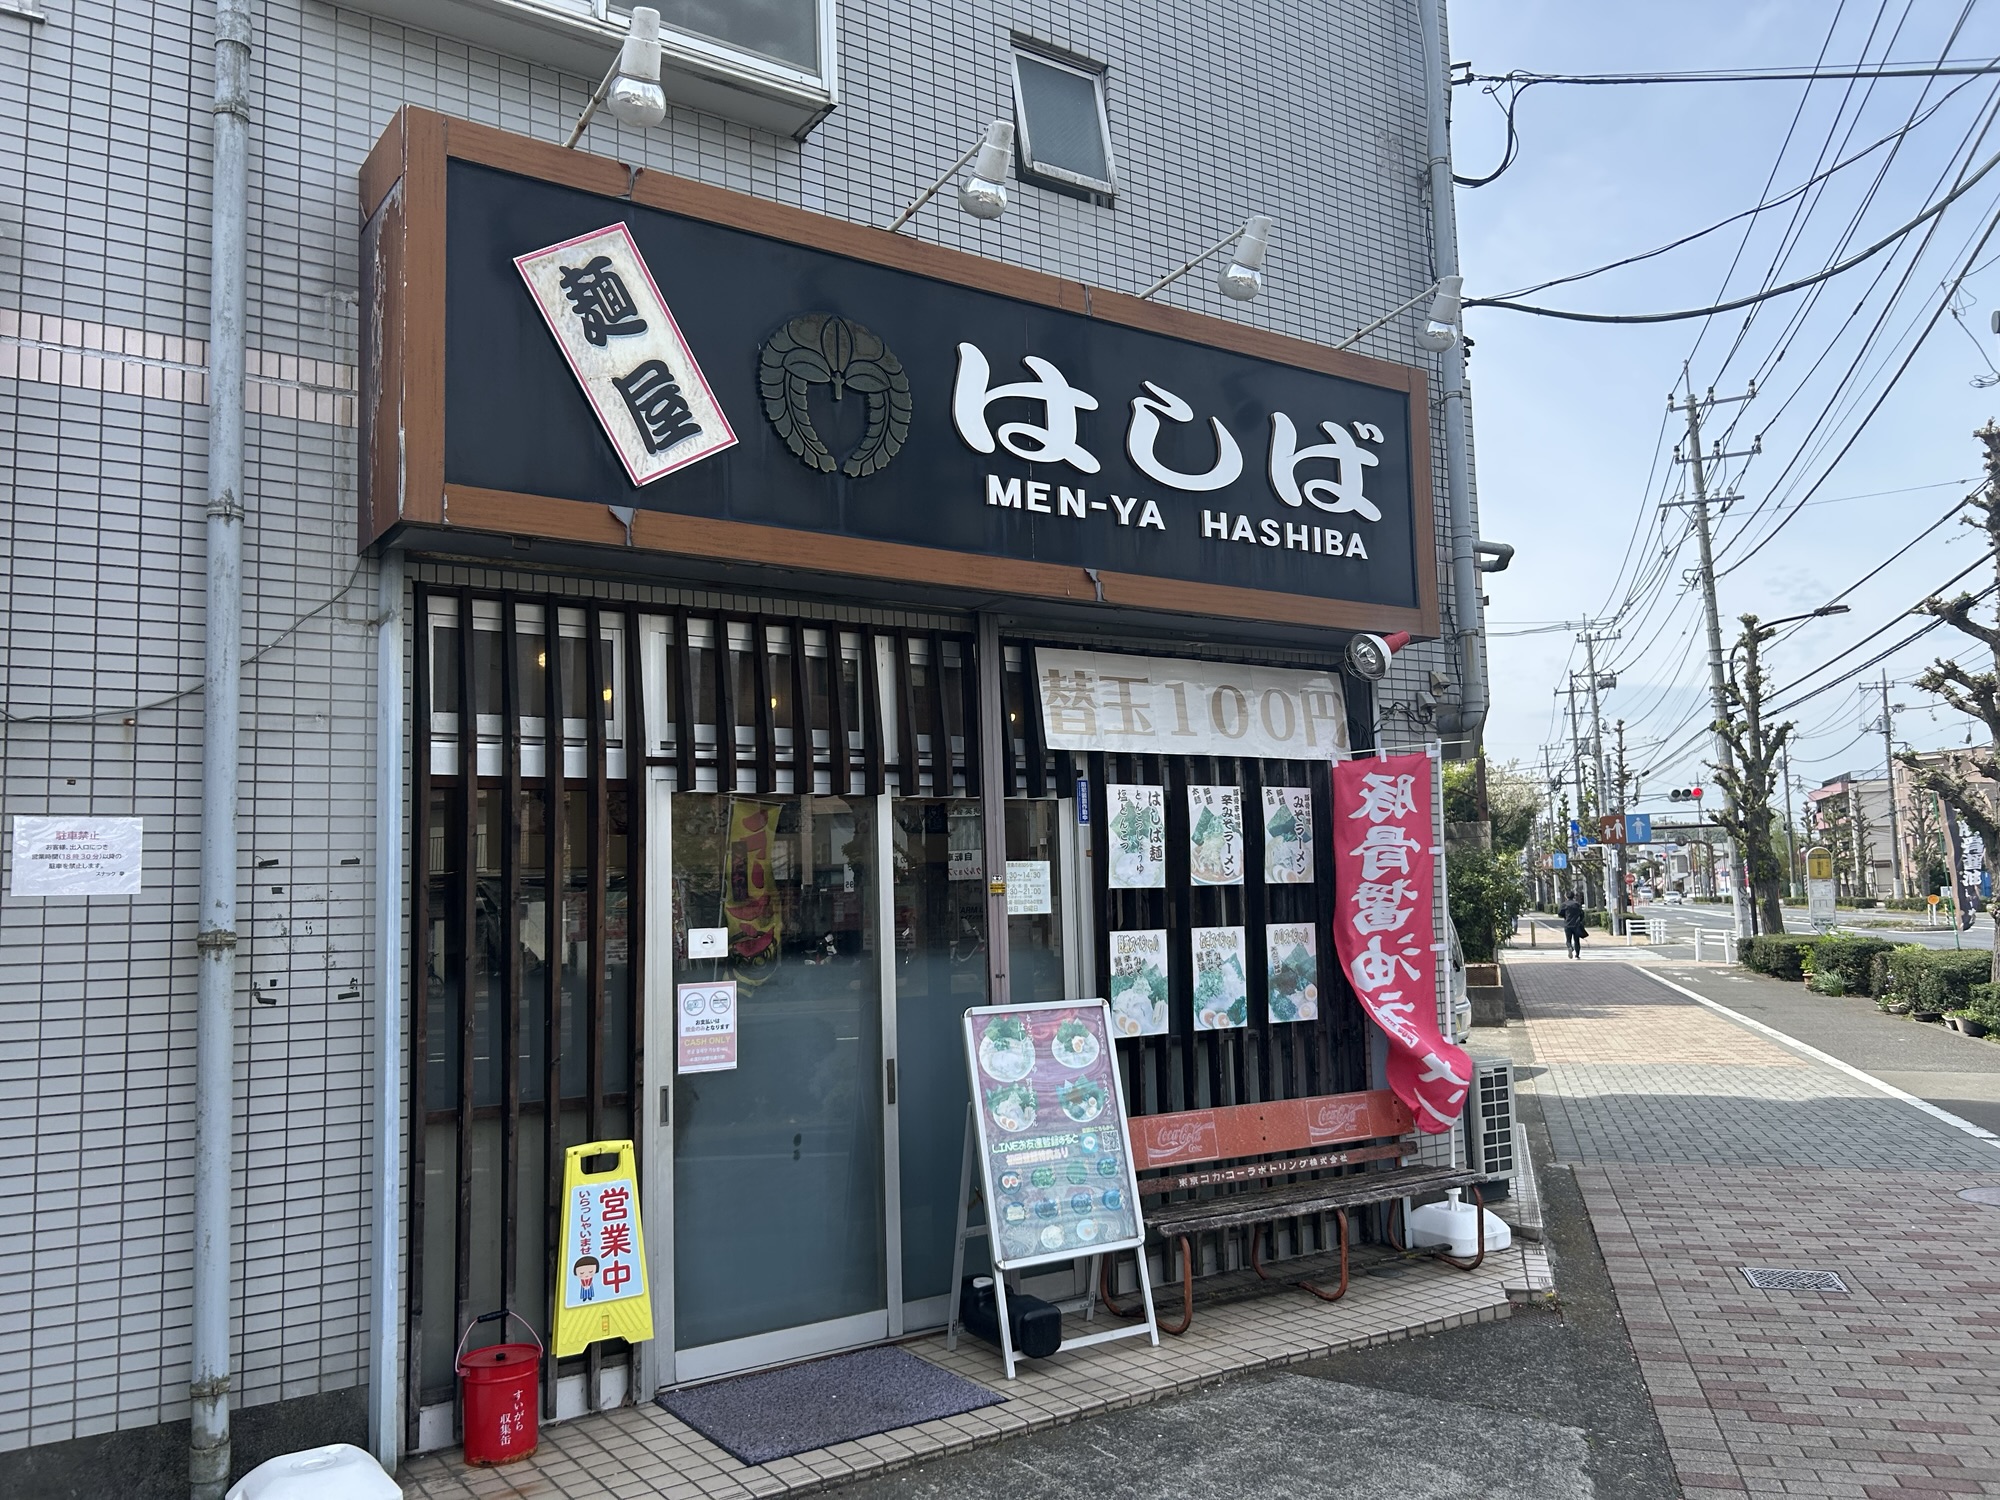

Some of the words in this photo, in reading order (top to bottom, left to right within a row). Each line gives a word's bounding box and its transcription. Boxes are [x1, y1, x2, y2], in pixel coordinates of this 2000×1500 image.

[558, 254, 704, 455] 麺屋
[952, 341, 1385, 523] はしば
[985, 473, 1167, 532] MEN-YA
[1201, 509, 1369, 560] HASHIBA
[1041, 668, 1349, 749] 替玉100円
[56, 831, 100, 840] 駐車禁止
[1117, 789, 1129, 853] 塩とんこつ
[1135, 789, 1144, 874] とんこつしょうゆ
[1148, 790, 1163, 862] はしば麺
[1221, 794, 1234, 877] 辛みそラーメン
[1293, 795, 1305, 875] みそラーメン
[684, 1038, 707, 1047] CASH
[709, 1036, 731, 1044] ONLY
[695, 1018, 720, 1026] お支払いは
[1157, 1122, 1202, 1147] Coca-Cola
[1178, 1154, 1348, 1188] 東京コカ・コーラボトリング株式会社
[578, 1190, 592, 1255] いらっしゃいませ
[599, 1186, 632, 1294] 営業中
[500, 1413, 512, 1446] 収集缶
[513, 1389, 525, 1431] すいがら
